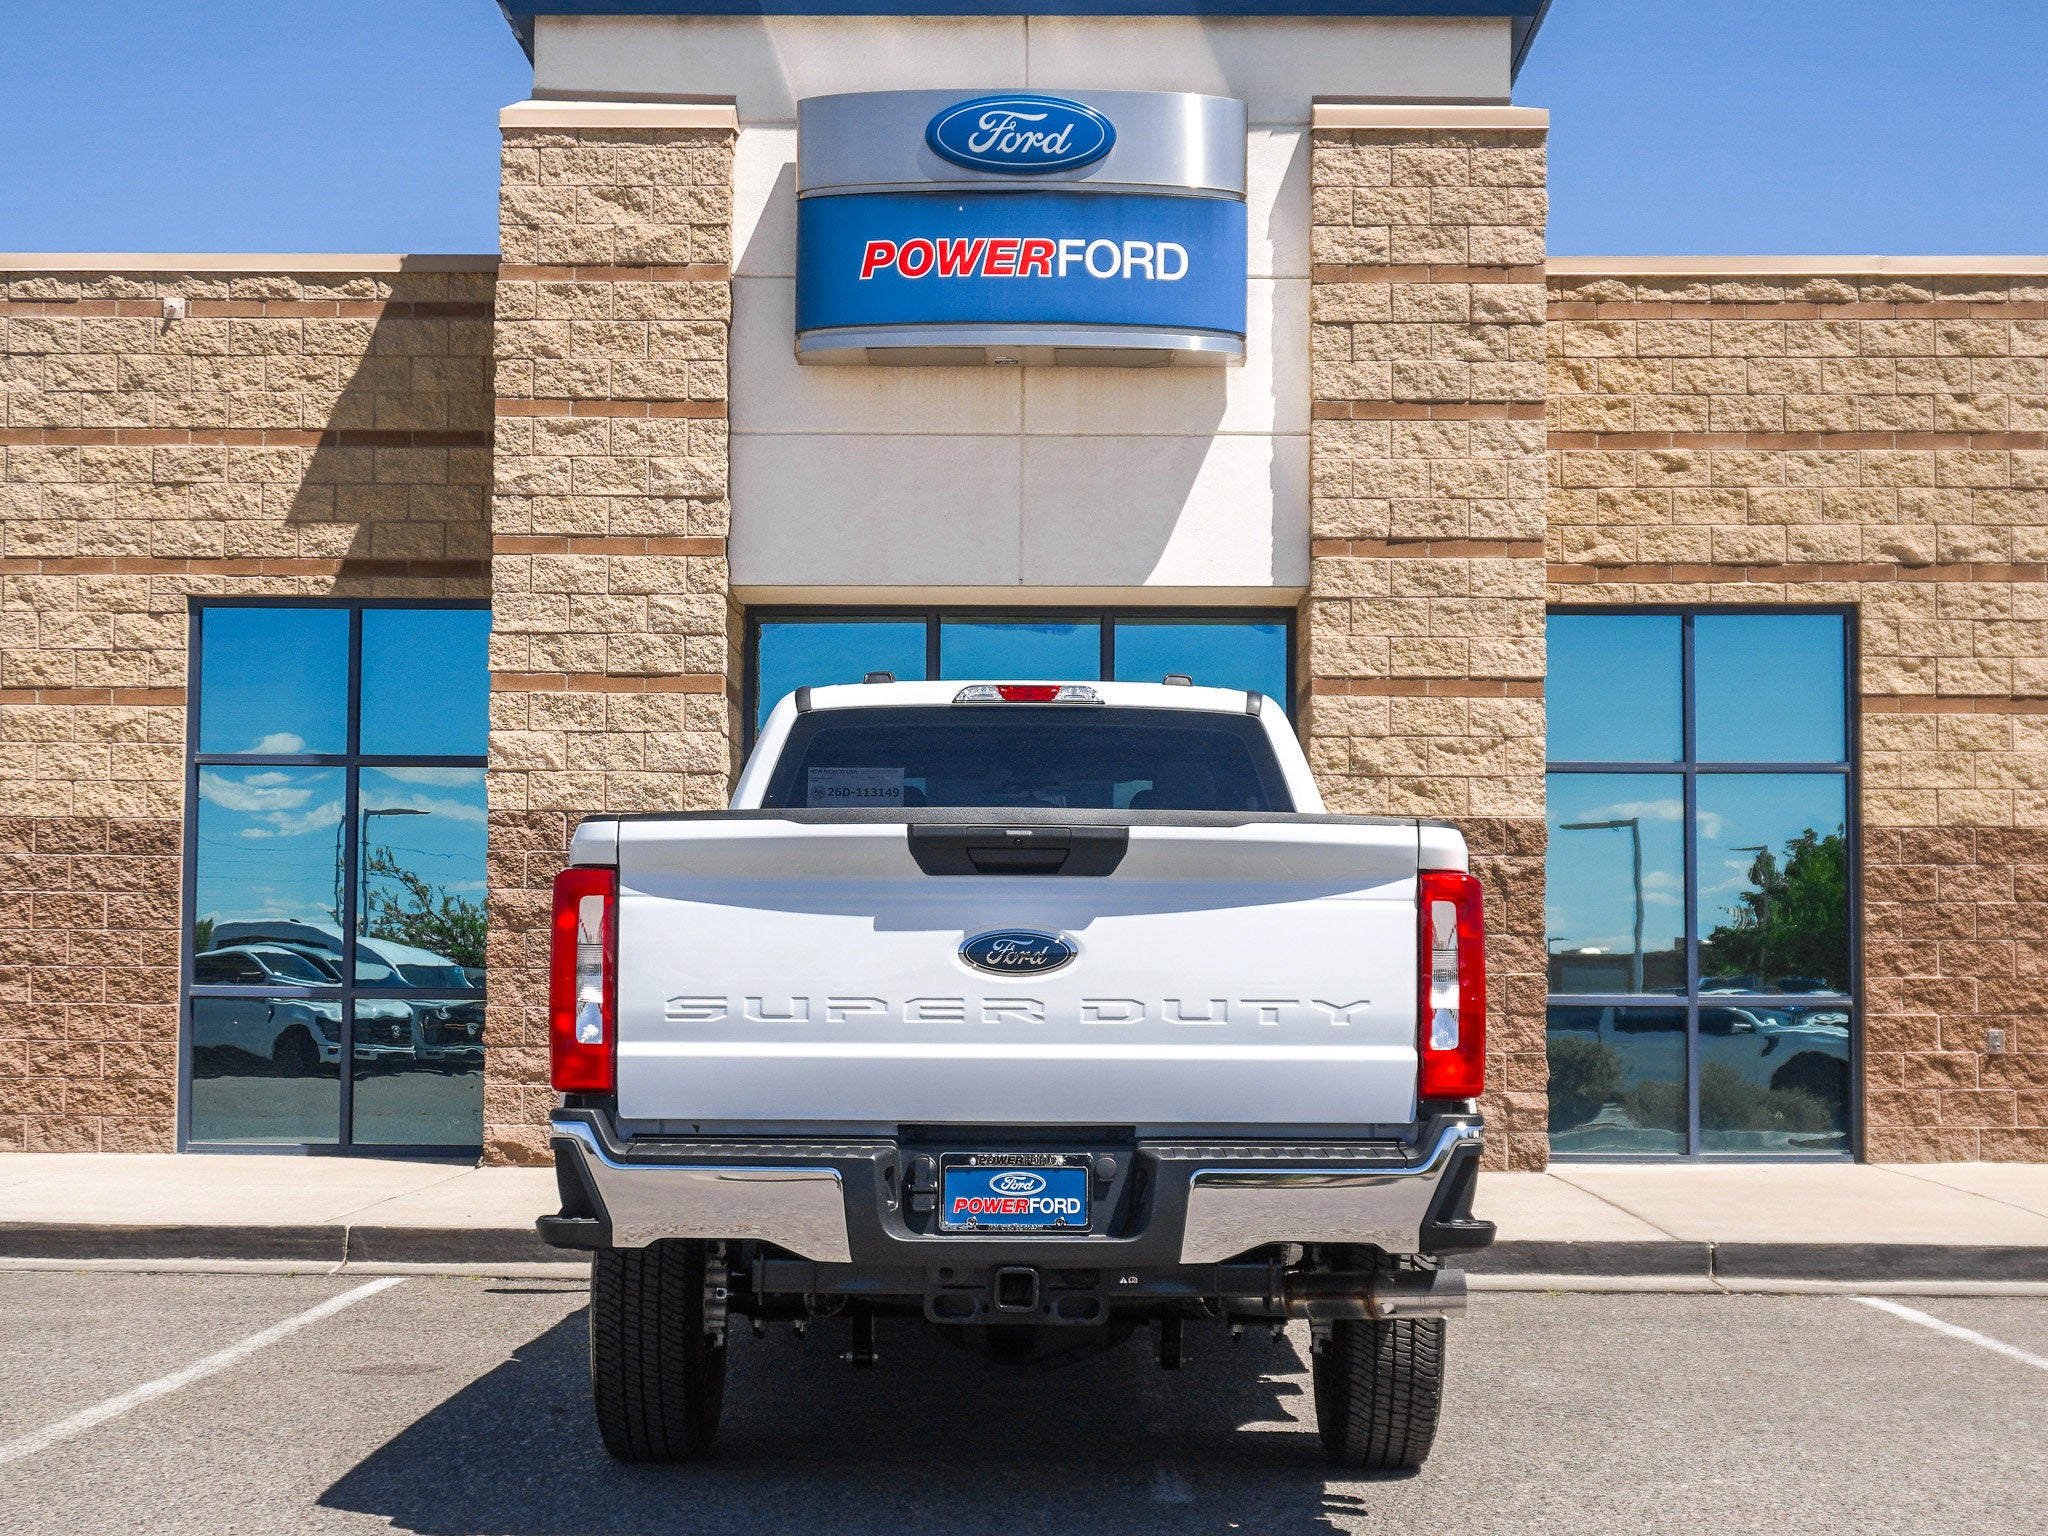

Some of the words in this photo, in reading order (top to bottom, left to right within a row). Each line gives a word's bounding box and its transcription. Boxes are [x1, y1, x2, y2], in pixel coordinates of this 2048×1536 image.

[968, 110, 1074, 156] Ford
[827, 787, 900, 798] 26D-113149
[987, 938, 1050, 968] Ford
[663, 996, 1047, 1025] SUPER
[1080, 997, 1371, 1027] DUTY
[1000, 1176, 1035, 1191] Ford
